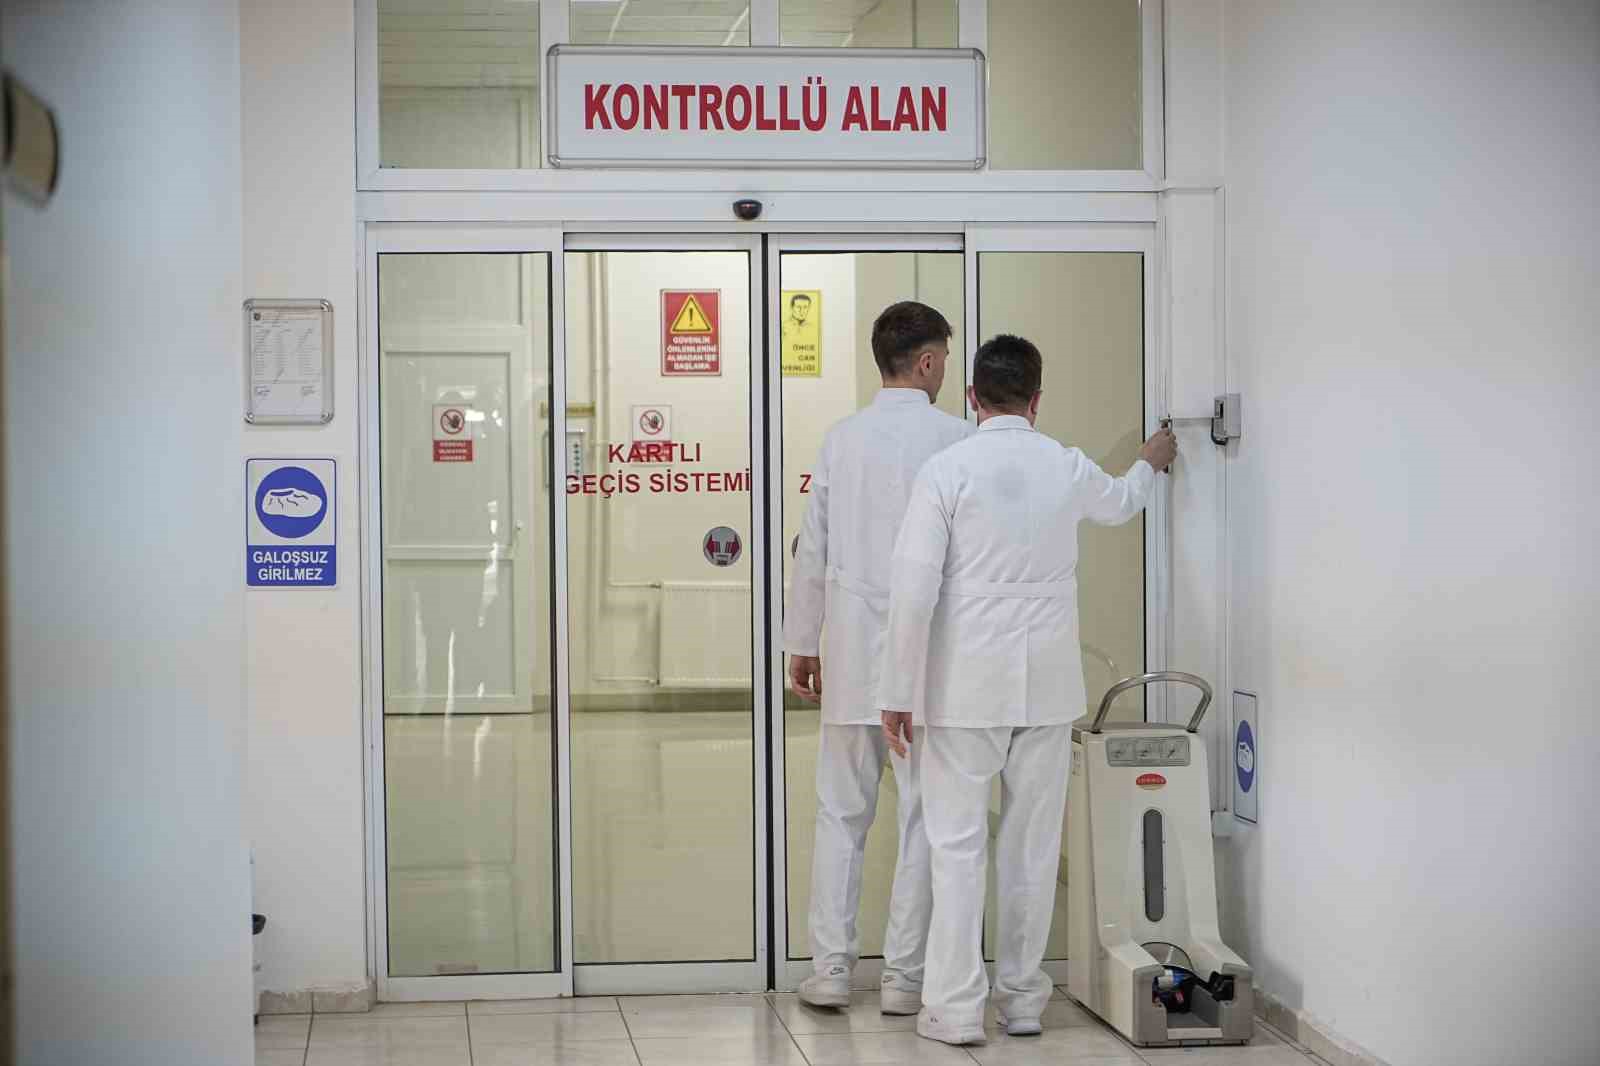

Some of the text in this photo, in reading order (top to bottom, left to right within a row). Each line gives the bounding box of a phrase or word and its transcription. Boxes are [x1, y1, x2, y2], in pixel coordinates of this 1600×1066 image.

[584, 76, 947, 131] KONTROLLÜ ALAN
[608, 442, 701, 463] KARTLI
[649, 468, 751, 493] SİSTEMİ
[253, 551, 328, 567] GALOŞSUZ
[258, 565, 323, 581] GİRİLMEZ
